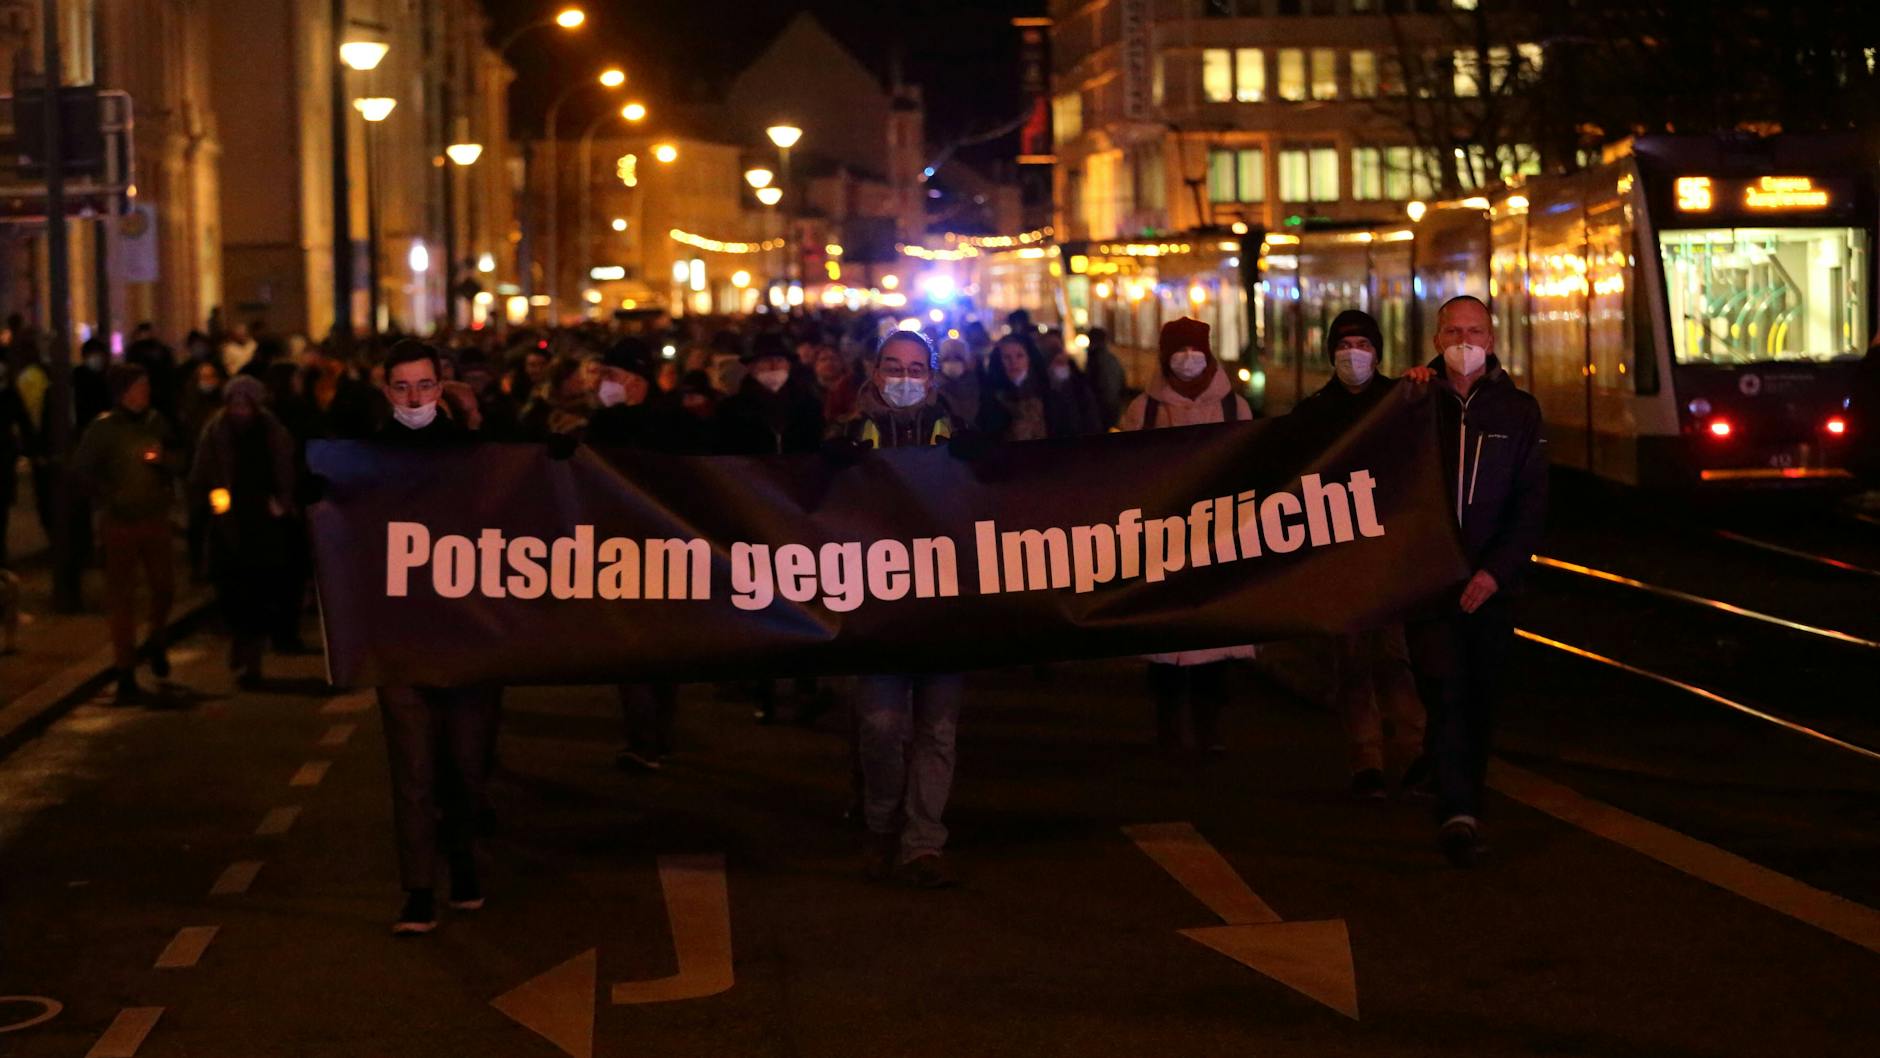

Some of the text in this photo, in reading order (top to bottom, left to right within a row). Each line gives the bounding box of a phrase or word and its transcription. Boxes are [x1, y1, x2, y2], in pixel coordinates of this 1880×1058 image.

[386, 469, 1386, 613] Potsdam gegen Impfpflicht
